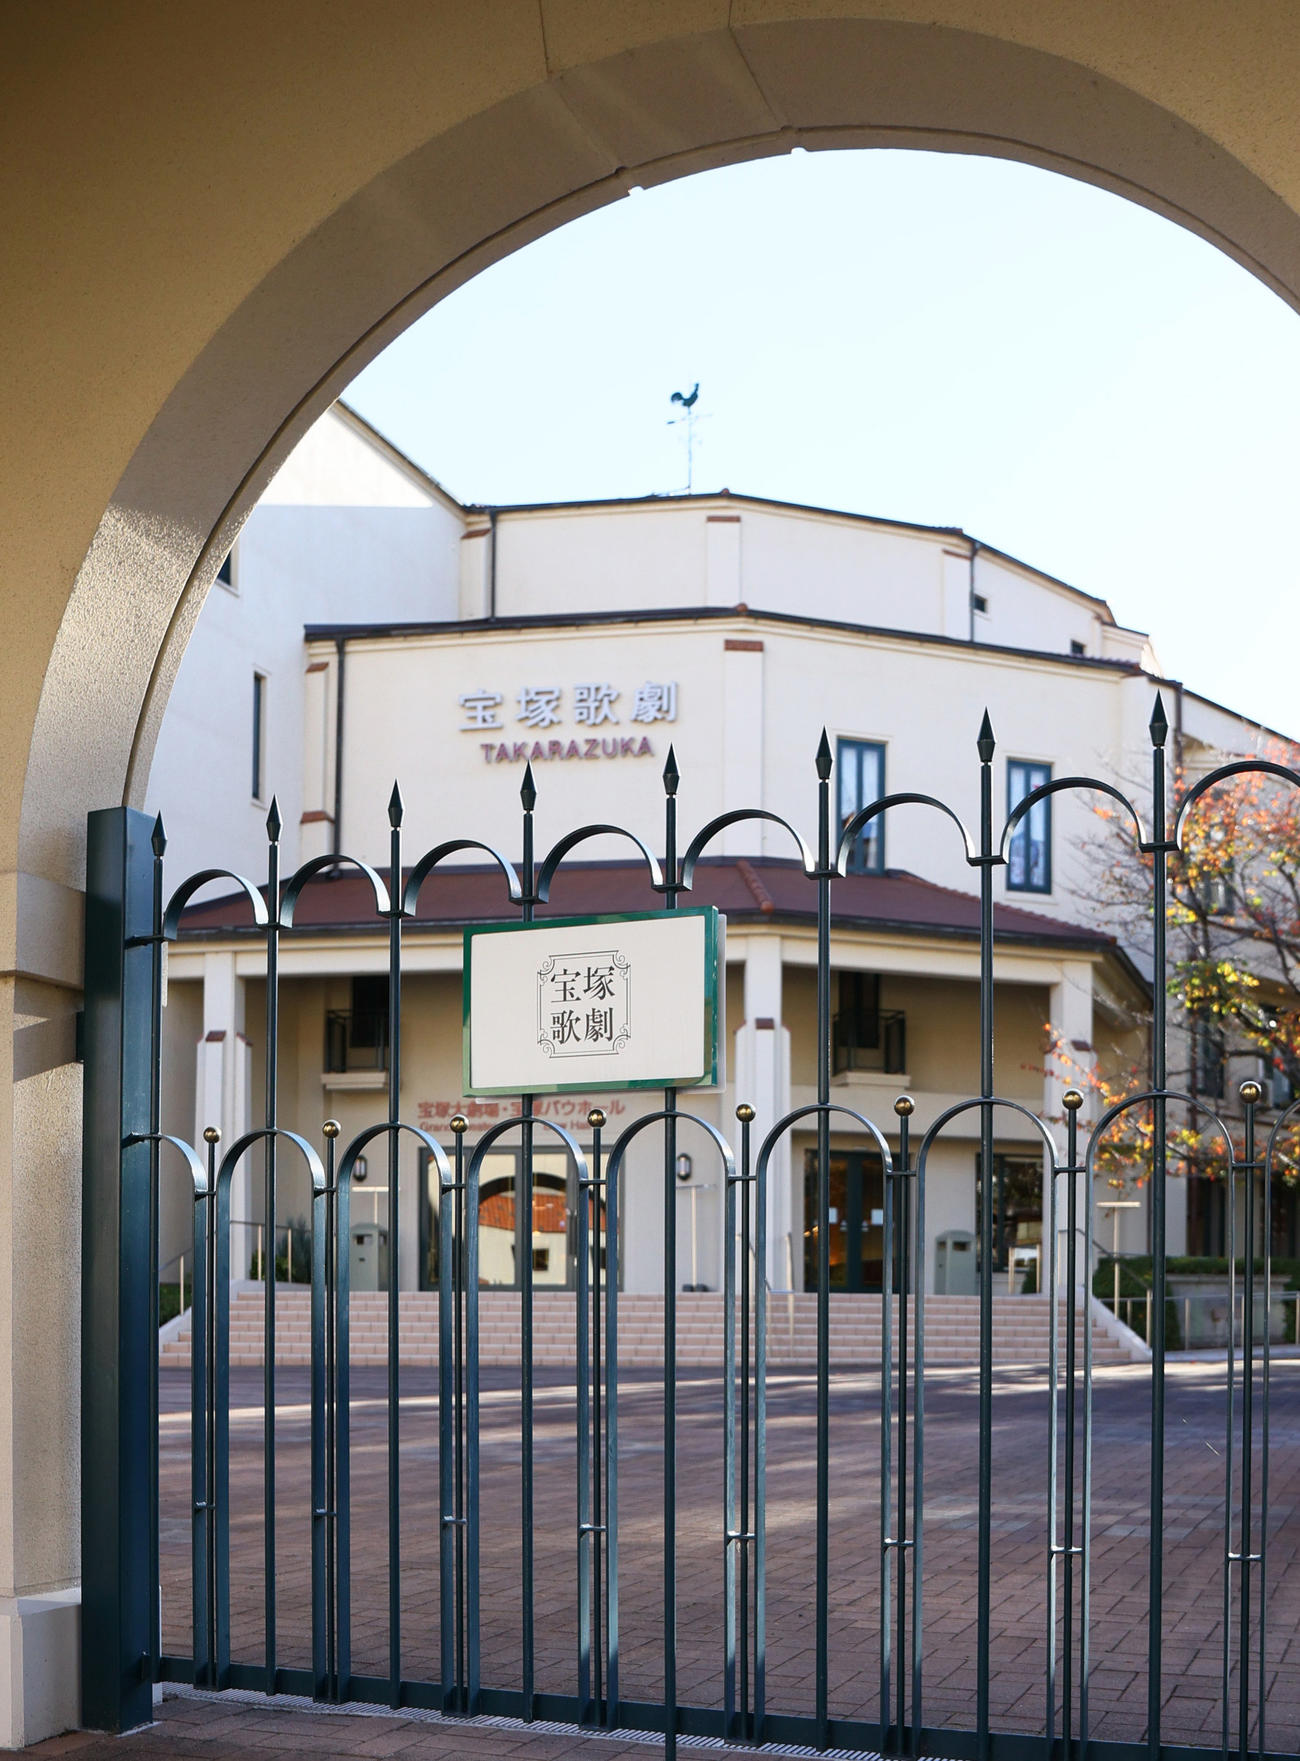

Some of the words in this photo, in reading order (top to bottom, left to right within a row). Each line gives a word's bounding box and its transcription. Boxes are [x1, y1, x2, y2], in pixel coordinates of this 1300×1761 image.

[458, 680, 679, 732] 宝塚歌劇
[480, 736, 655, 764] TAKARAZUKA
[550, 966, 616, 1004] 宝塚
[550, 1007, 614, 1045] 歌劇
